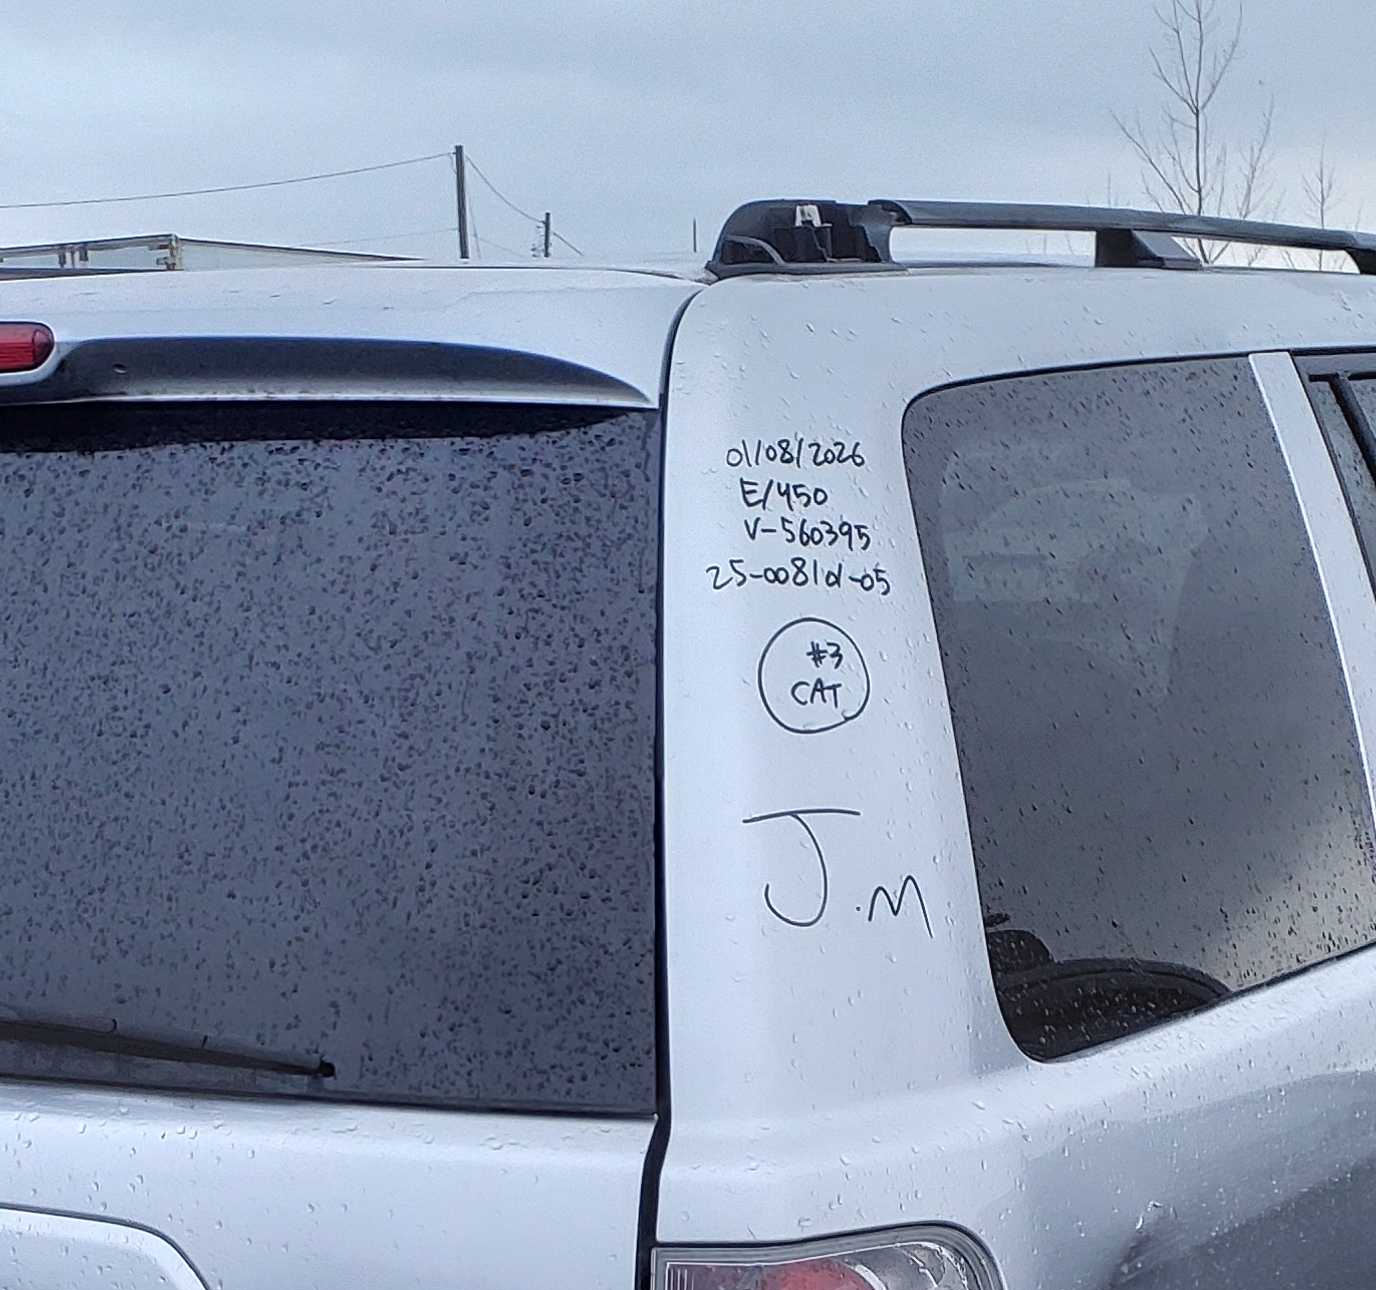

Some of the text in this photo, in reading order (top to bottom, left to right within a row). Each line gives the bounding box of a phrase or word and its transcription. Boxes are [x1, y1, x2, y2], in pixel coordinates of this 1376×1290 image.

[726, 437, 866, 469] 01/08/2026
[739, 477, 829, 512] E/450
[806, 640, 844, 668] #3
[790, 681, 844, 709] CAT
